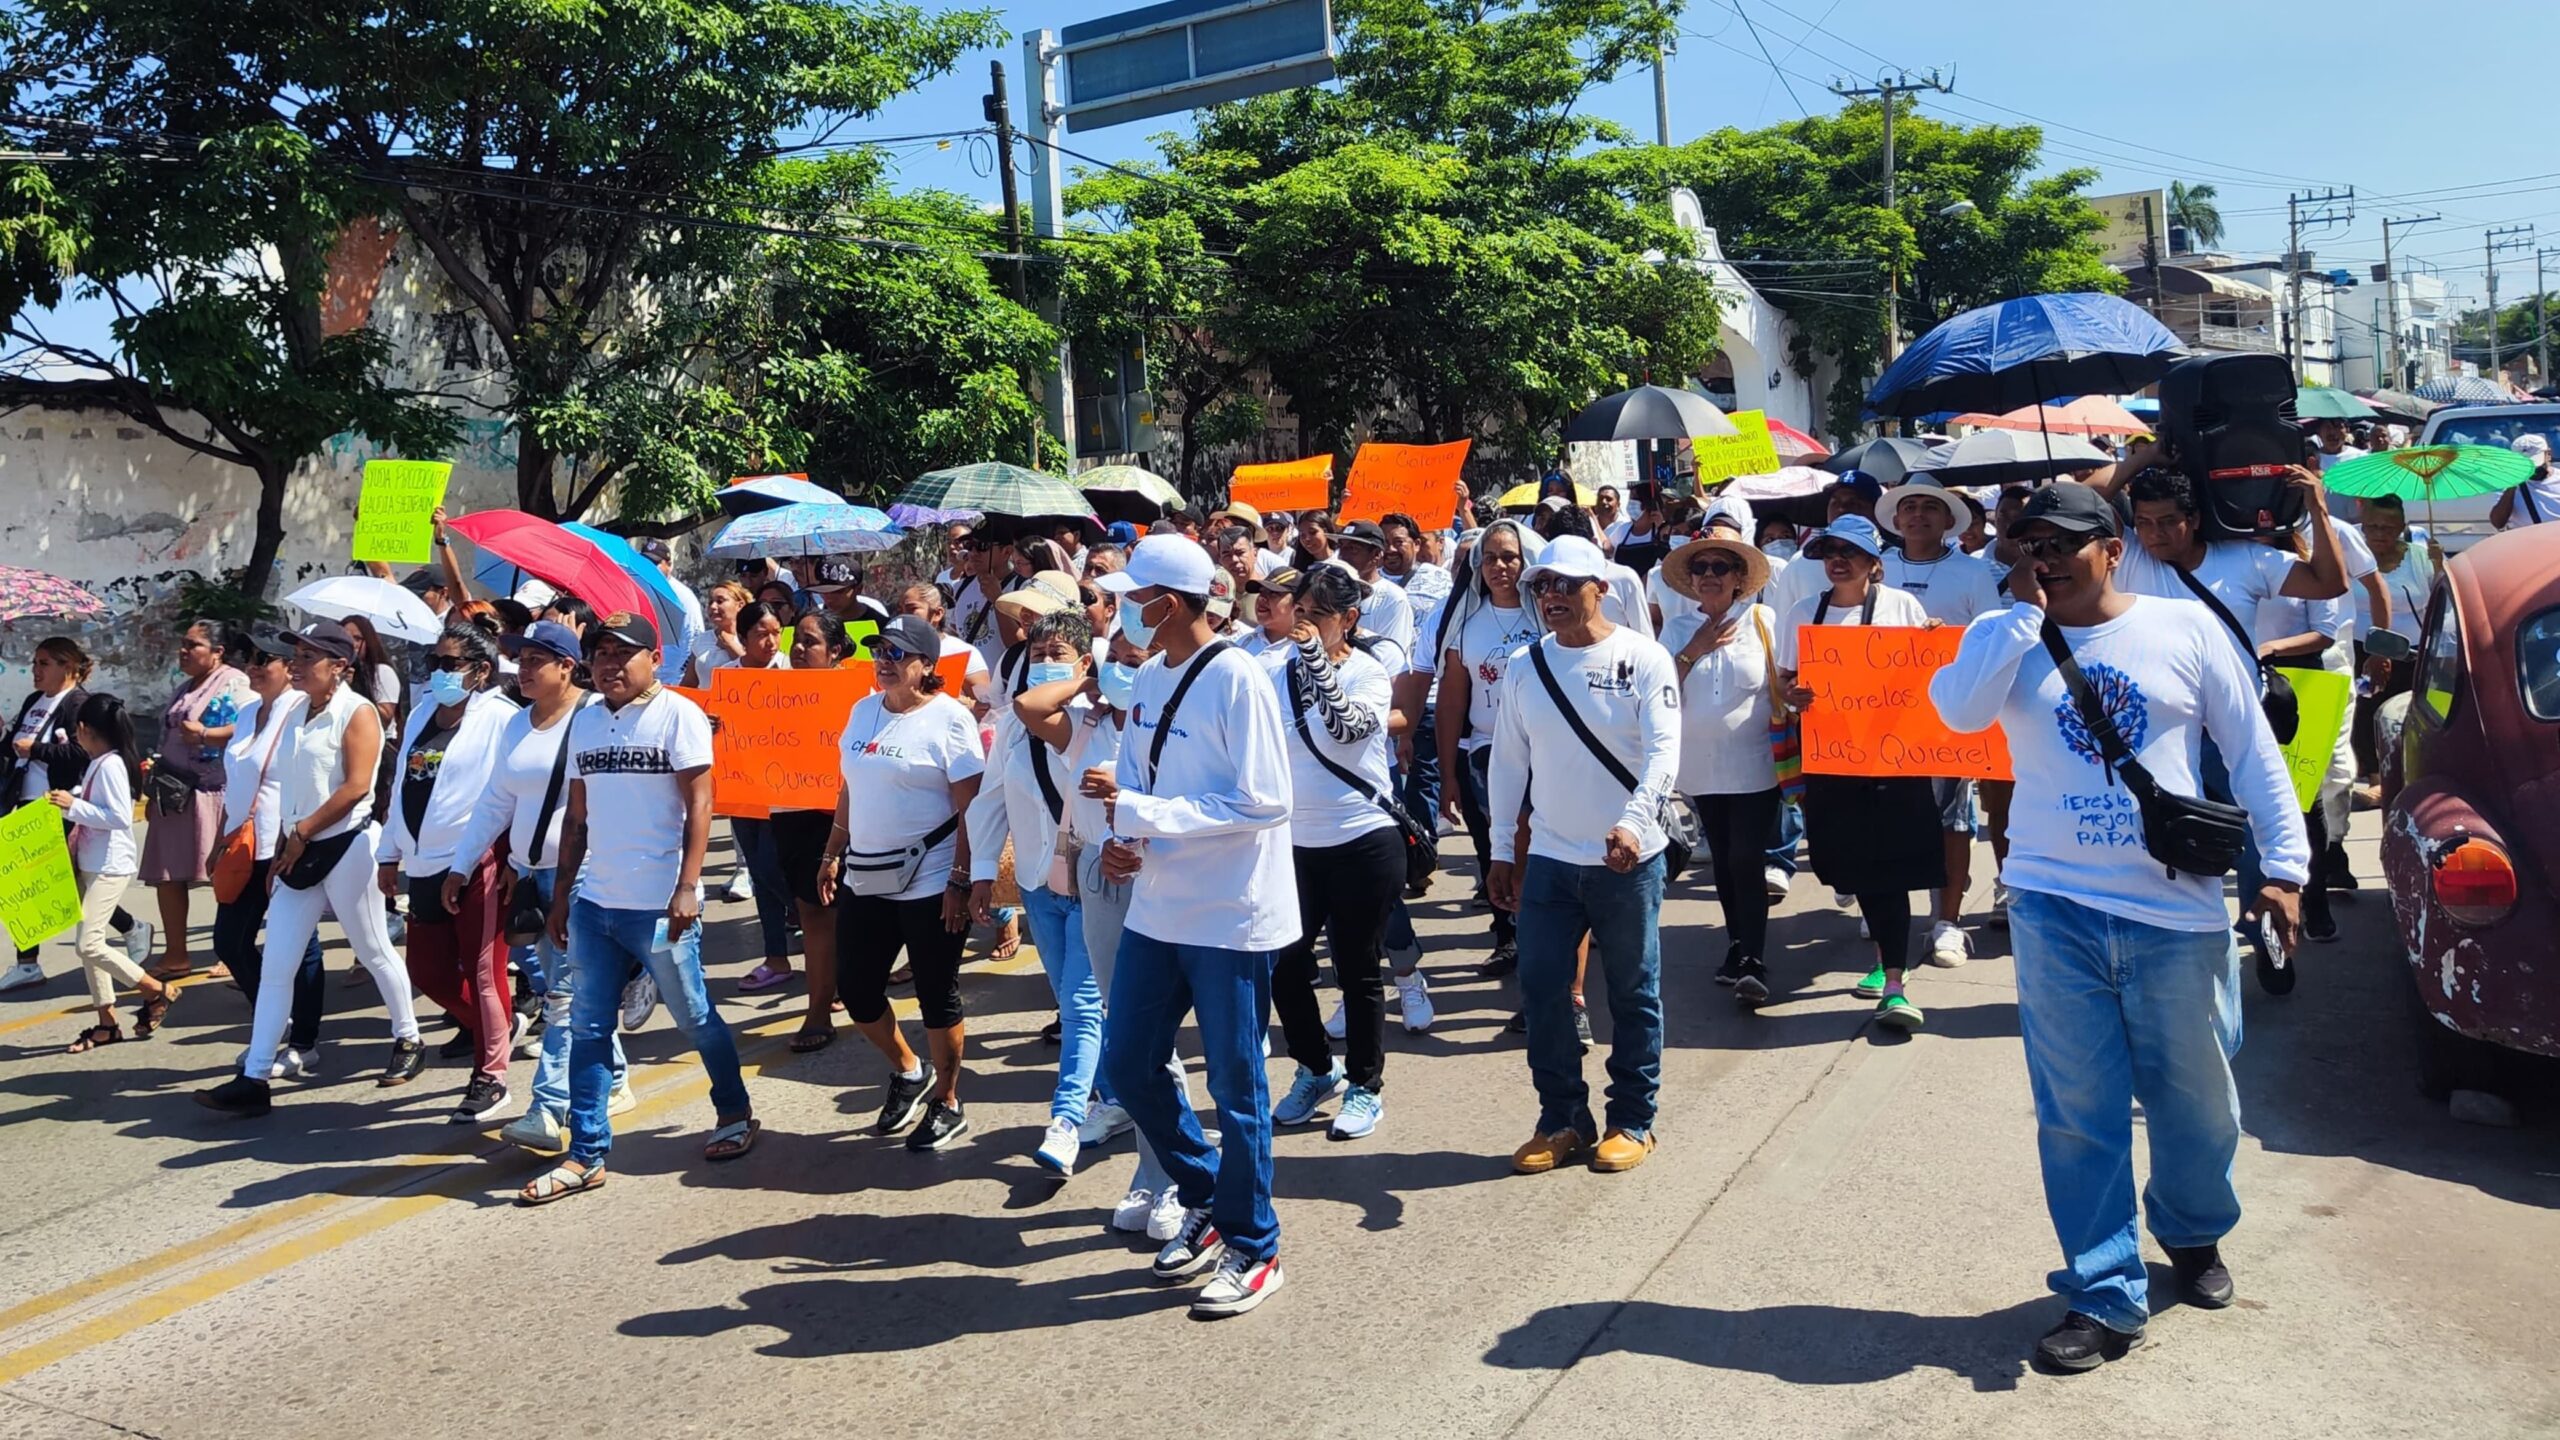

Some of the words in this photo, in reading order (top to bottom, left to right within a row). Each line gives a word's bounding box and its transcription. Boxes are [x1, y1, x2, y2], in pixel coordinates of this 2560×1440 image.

[1800, 631, 1842, 666] La
[715, 672, 740, 703] La
[747, 680, 820, 711] Colonia
[720, 725, 801, 753] Morelos
[851, 740, 904, 759] CHANEL
[1810, 729, 1867, 764] Las
[1880, 733, 1992, 772] Quiere!
[722, 764, 754, 785] Las
